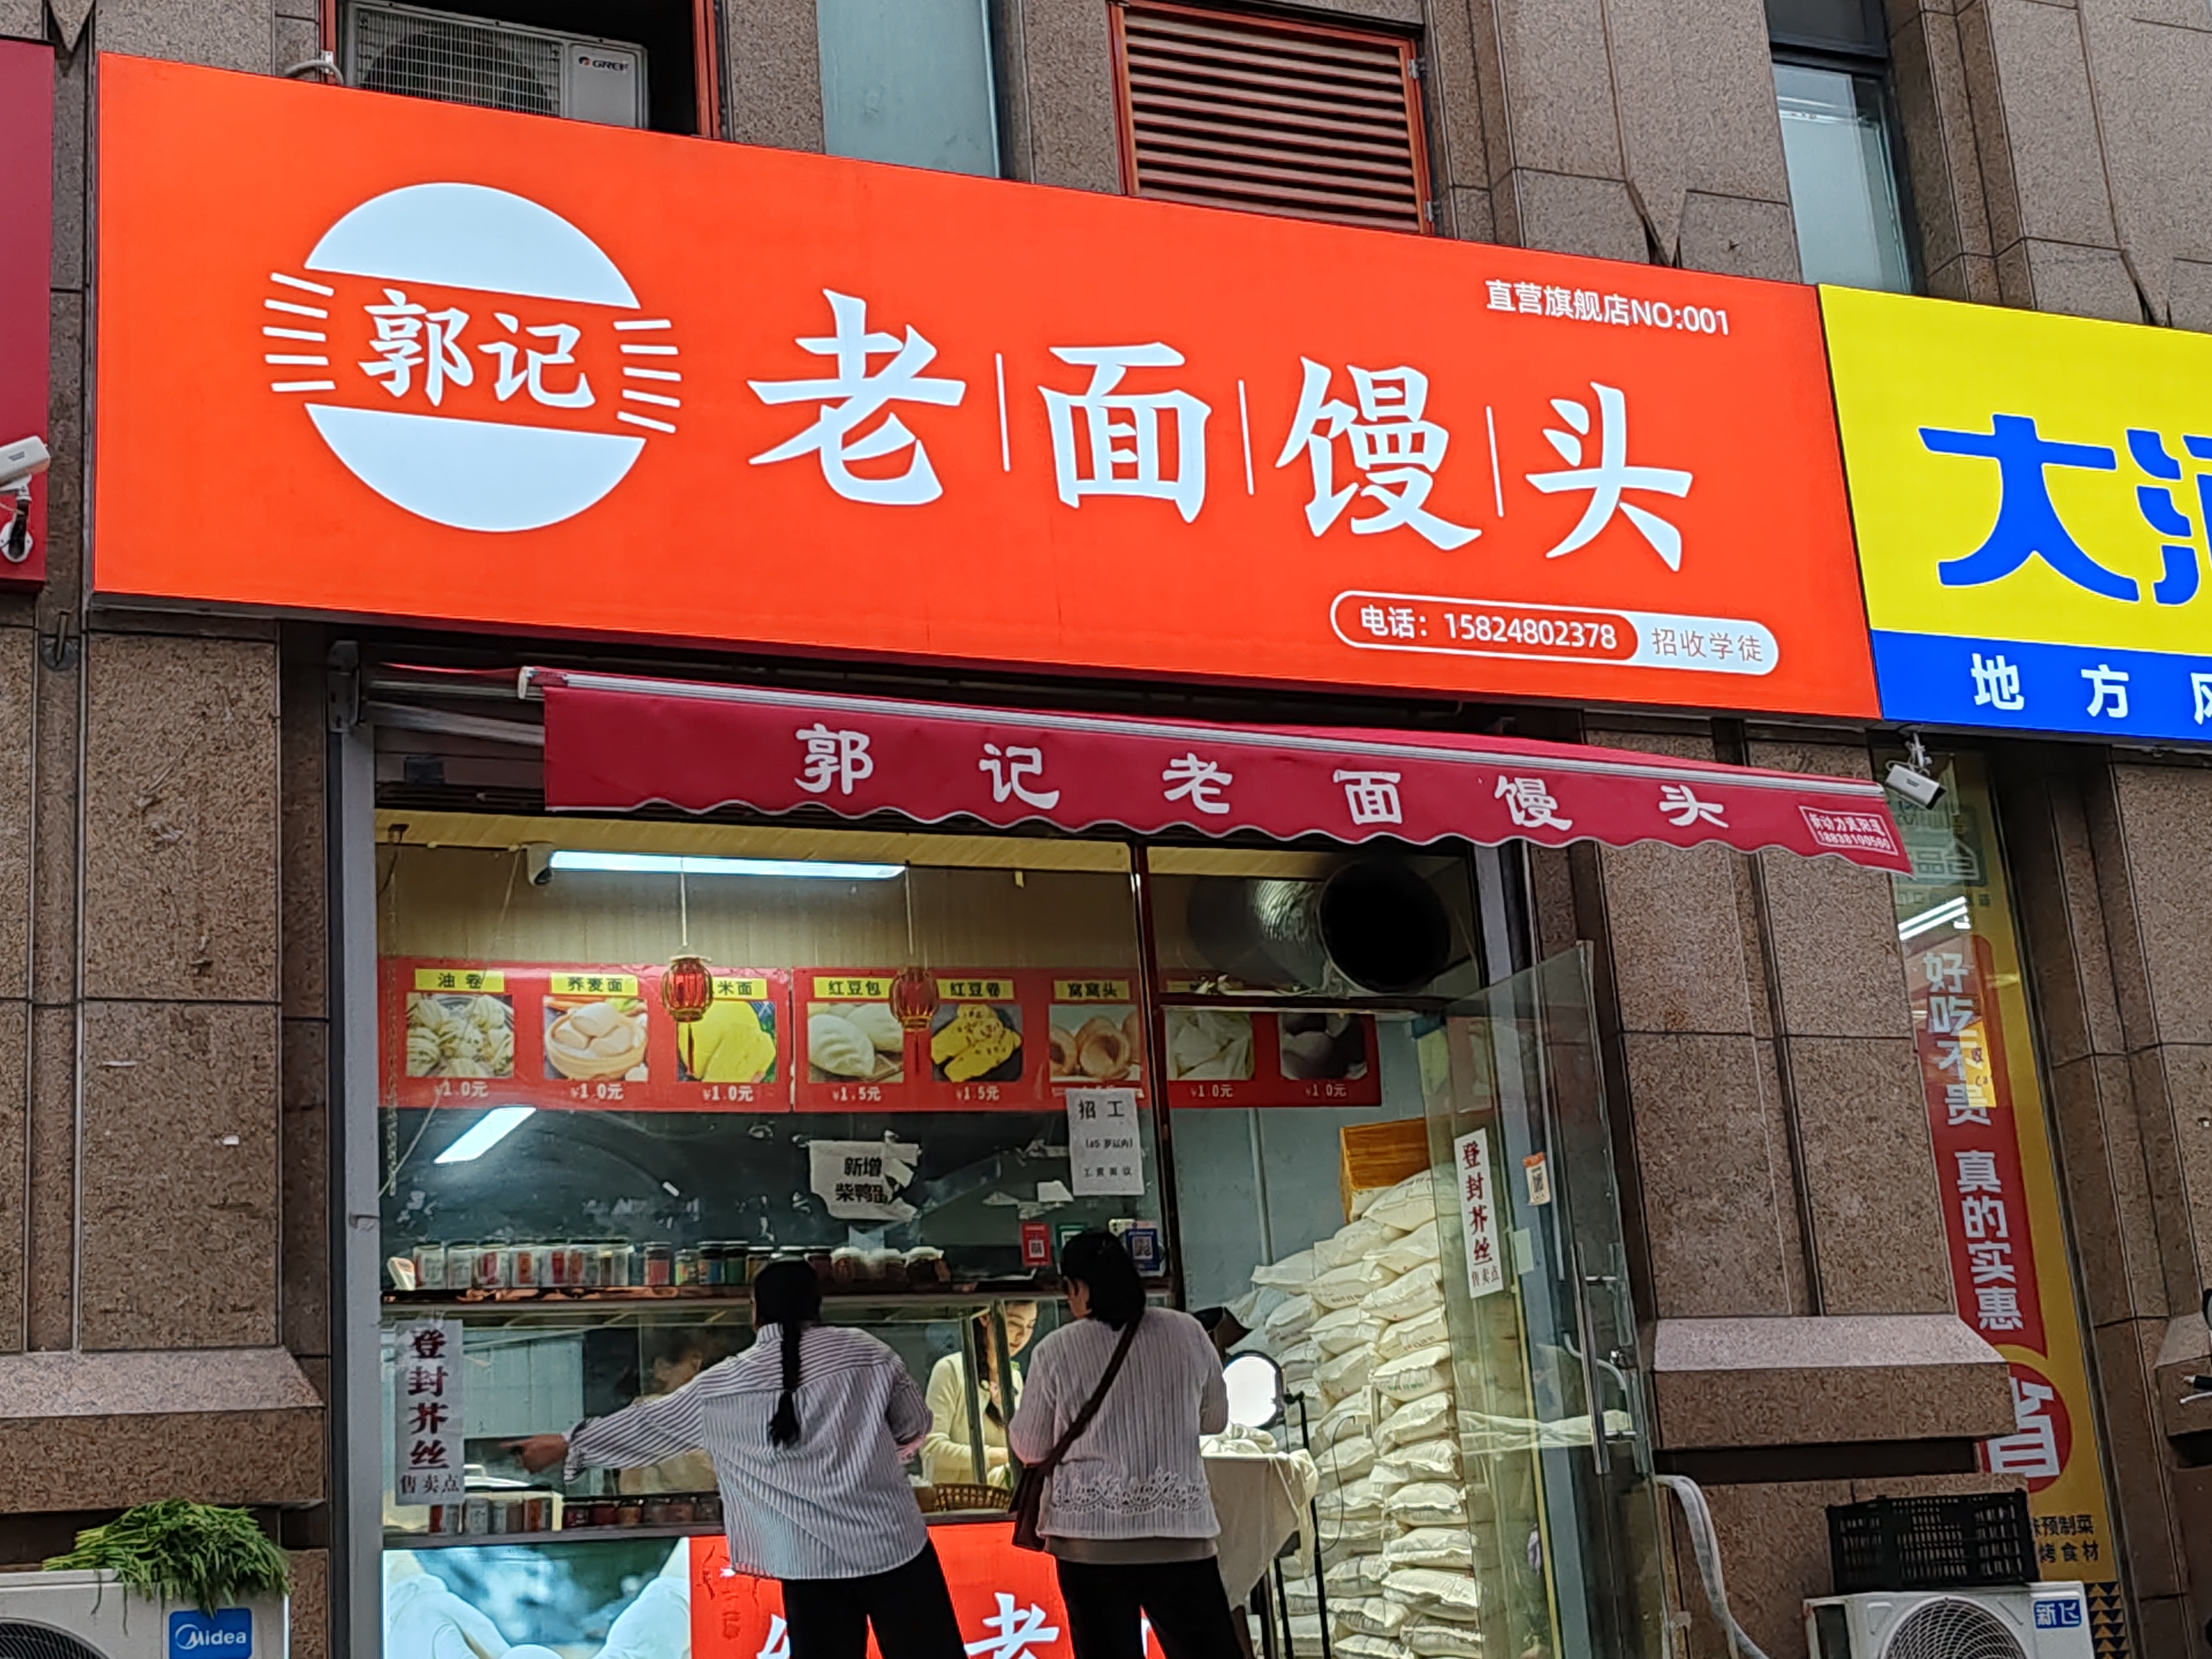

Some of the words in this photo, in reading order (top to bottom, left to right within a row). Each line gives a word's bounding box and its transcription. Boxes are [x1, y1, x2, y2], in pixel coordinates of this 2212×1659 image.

[1484, 279, 1729, 335] 直营旗舰店NO:001
[358, 288, 595, 408] 郭记
[748, 288, 1693, 572] 老面馒头
[1651, 627, 1764, 662] 招收学徒
[795, 723, 1728, 830] 郭记老面馒头
[711, 980, 753, 996] 米面
[828, 980, 881, 996] 红豆包
[1078, 1099, 1125, 1119] 招工
[844, 1157, 882, 1176] 新增
[1955, 1150, 2024, 1330] 真的实惠
[401, 1474, 459, 1494] 售卖点
[2036, 1602, 2081, 1626] 新飞
[182, 1626, 247, 1648] Midea
